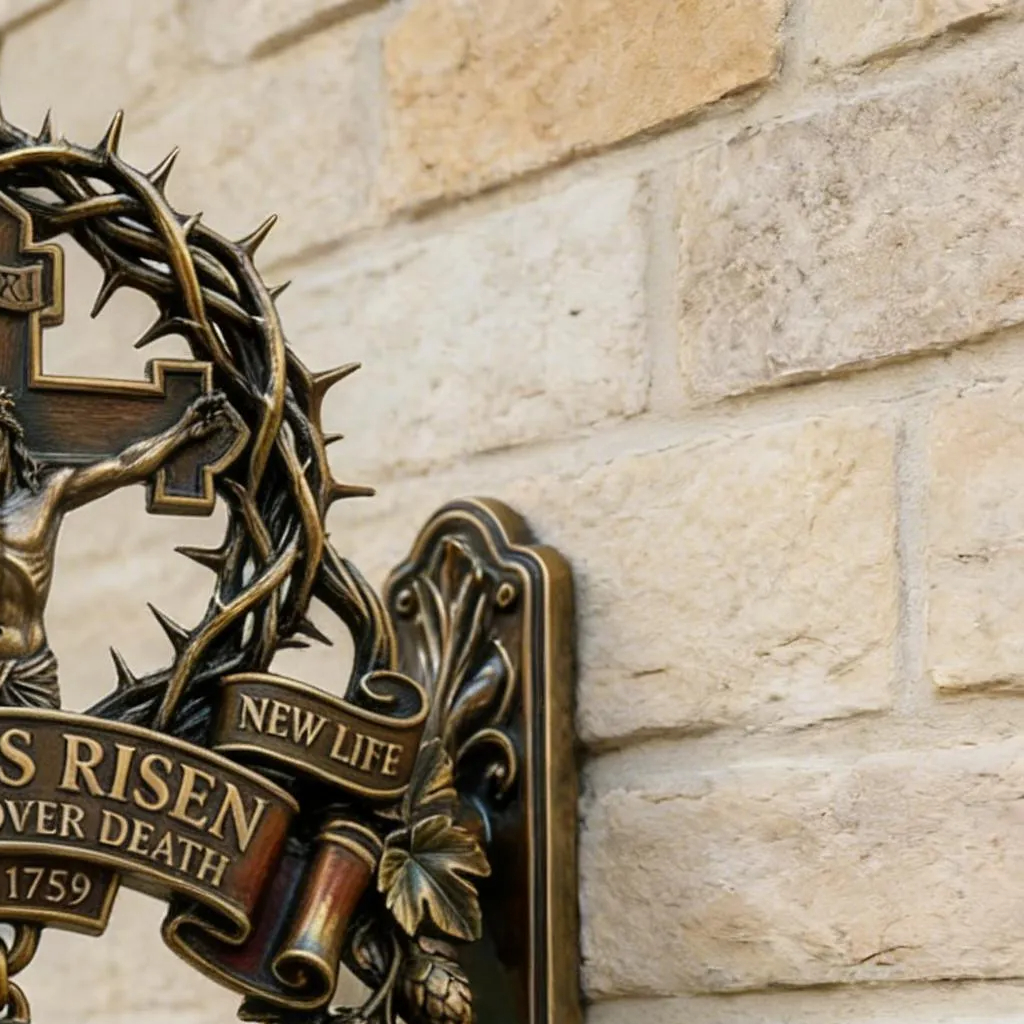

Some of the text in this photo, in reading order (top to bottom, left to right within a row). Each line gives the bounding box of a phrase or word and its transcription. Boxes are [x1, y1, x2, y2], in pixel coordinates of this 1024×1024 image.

[238, 693, 404, 778] NEW LIFE
[59, 733, 268, 853] RISEN
[4, 866, 93, 906] 1759
[98, 809, 230, 888] DEATH
